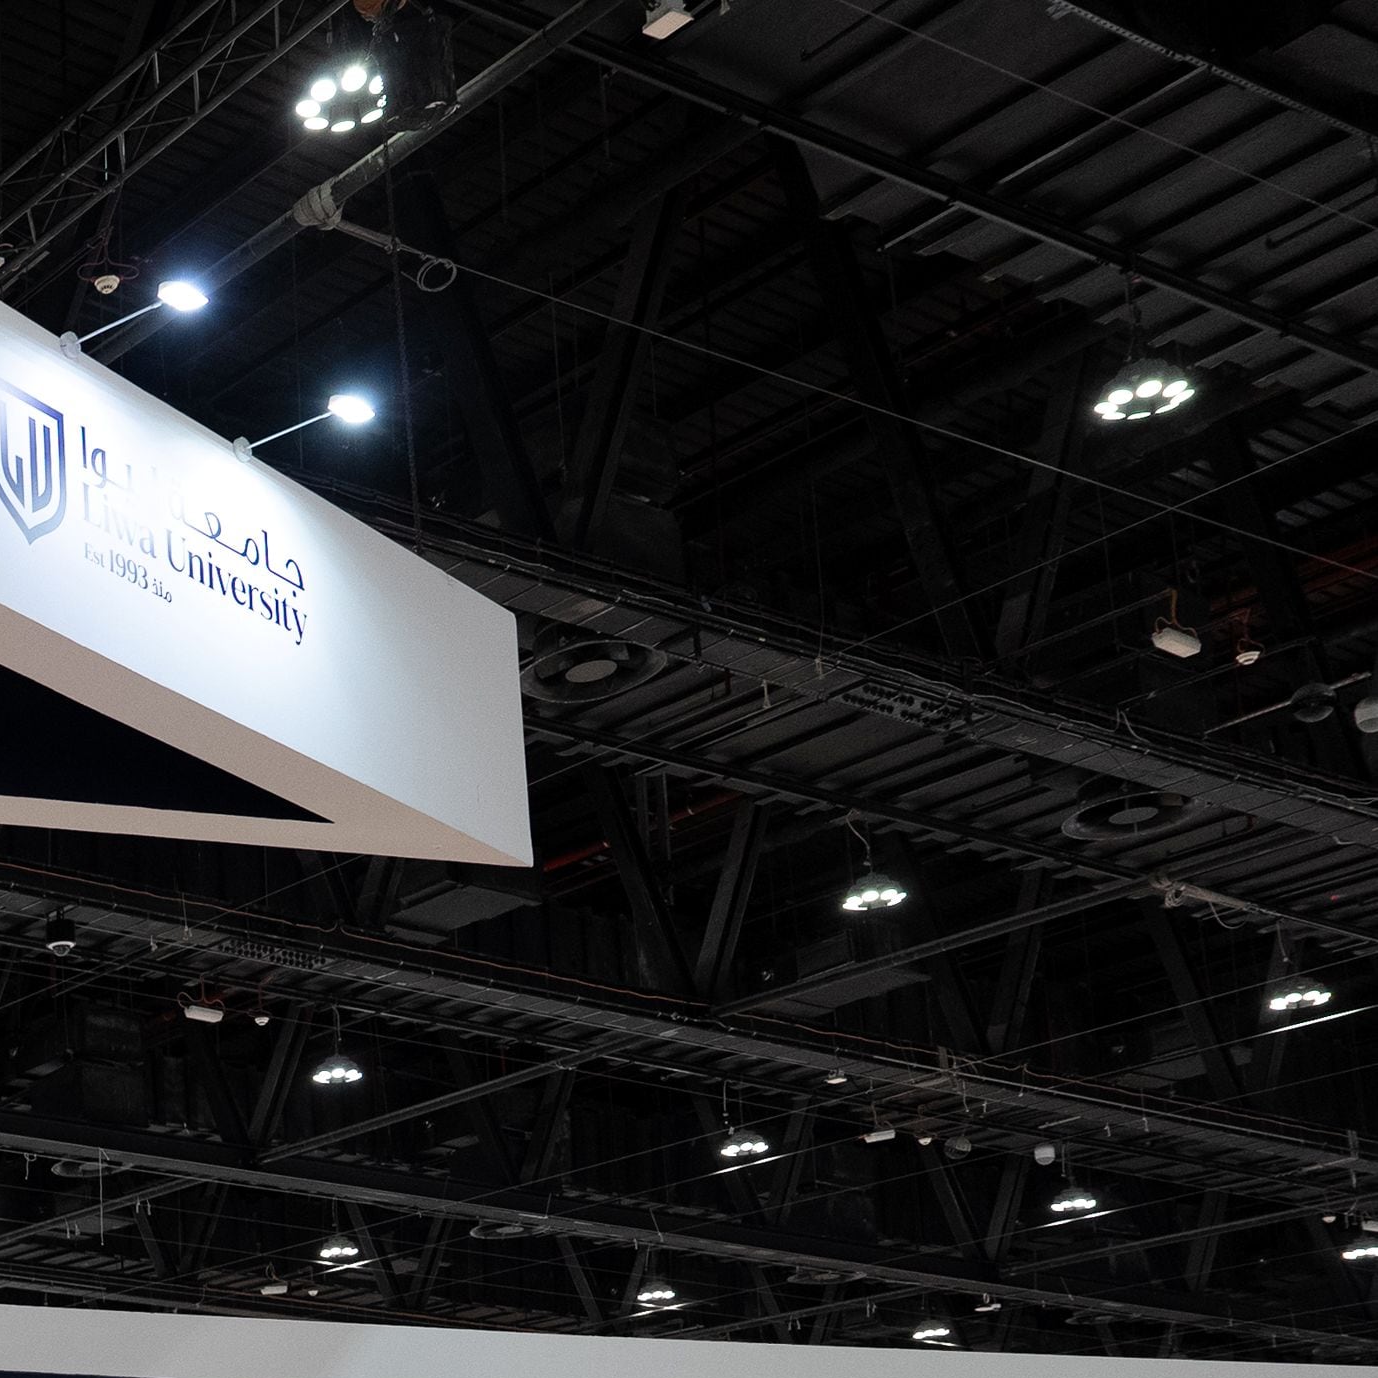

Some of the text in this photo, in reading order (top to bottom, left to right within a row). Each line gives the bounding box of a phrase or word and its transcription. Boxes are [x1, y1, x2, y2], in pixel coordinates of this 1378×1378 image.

[82, 482, 308, 646] Liwa University
[84, 541, 106, 569] Est
[108, 550, 149, 590] 1993
